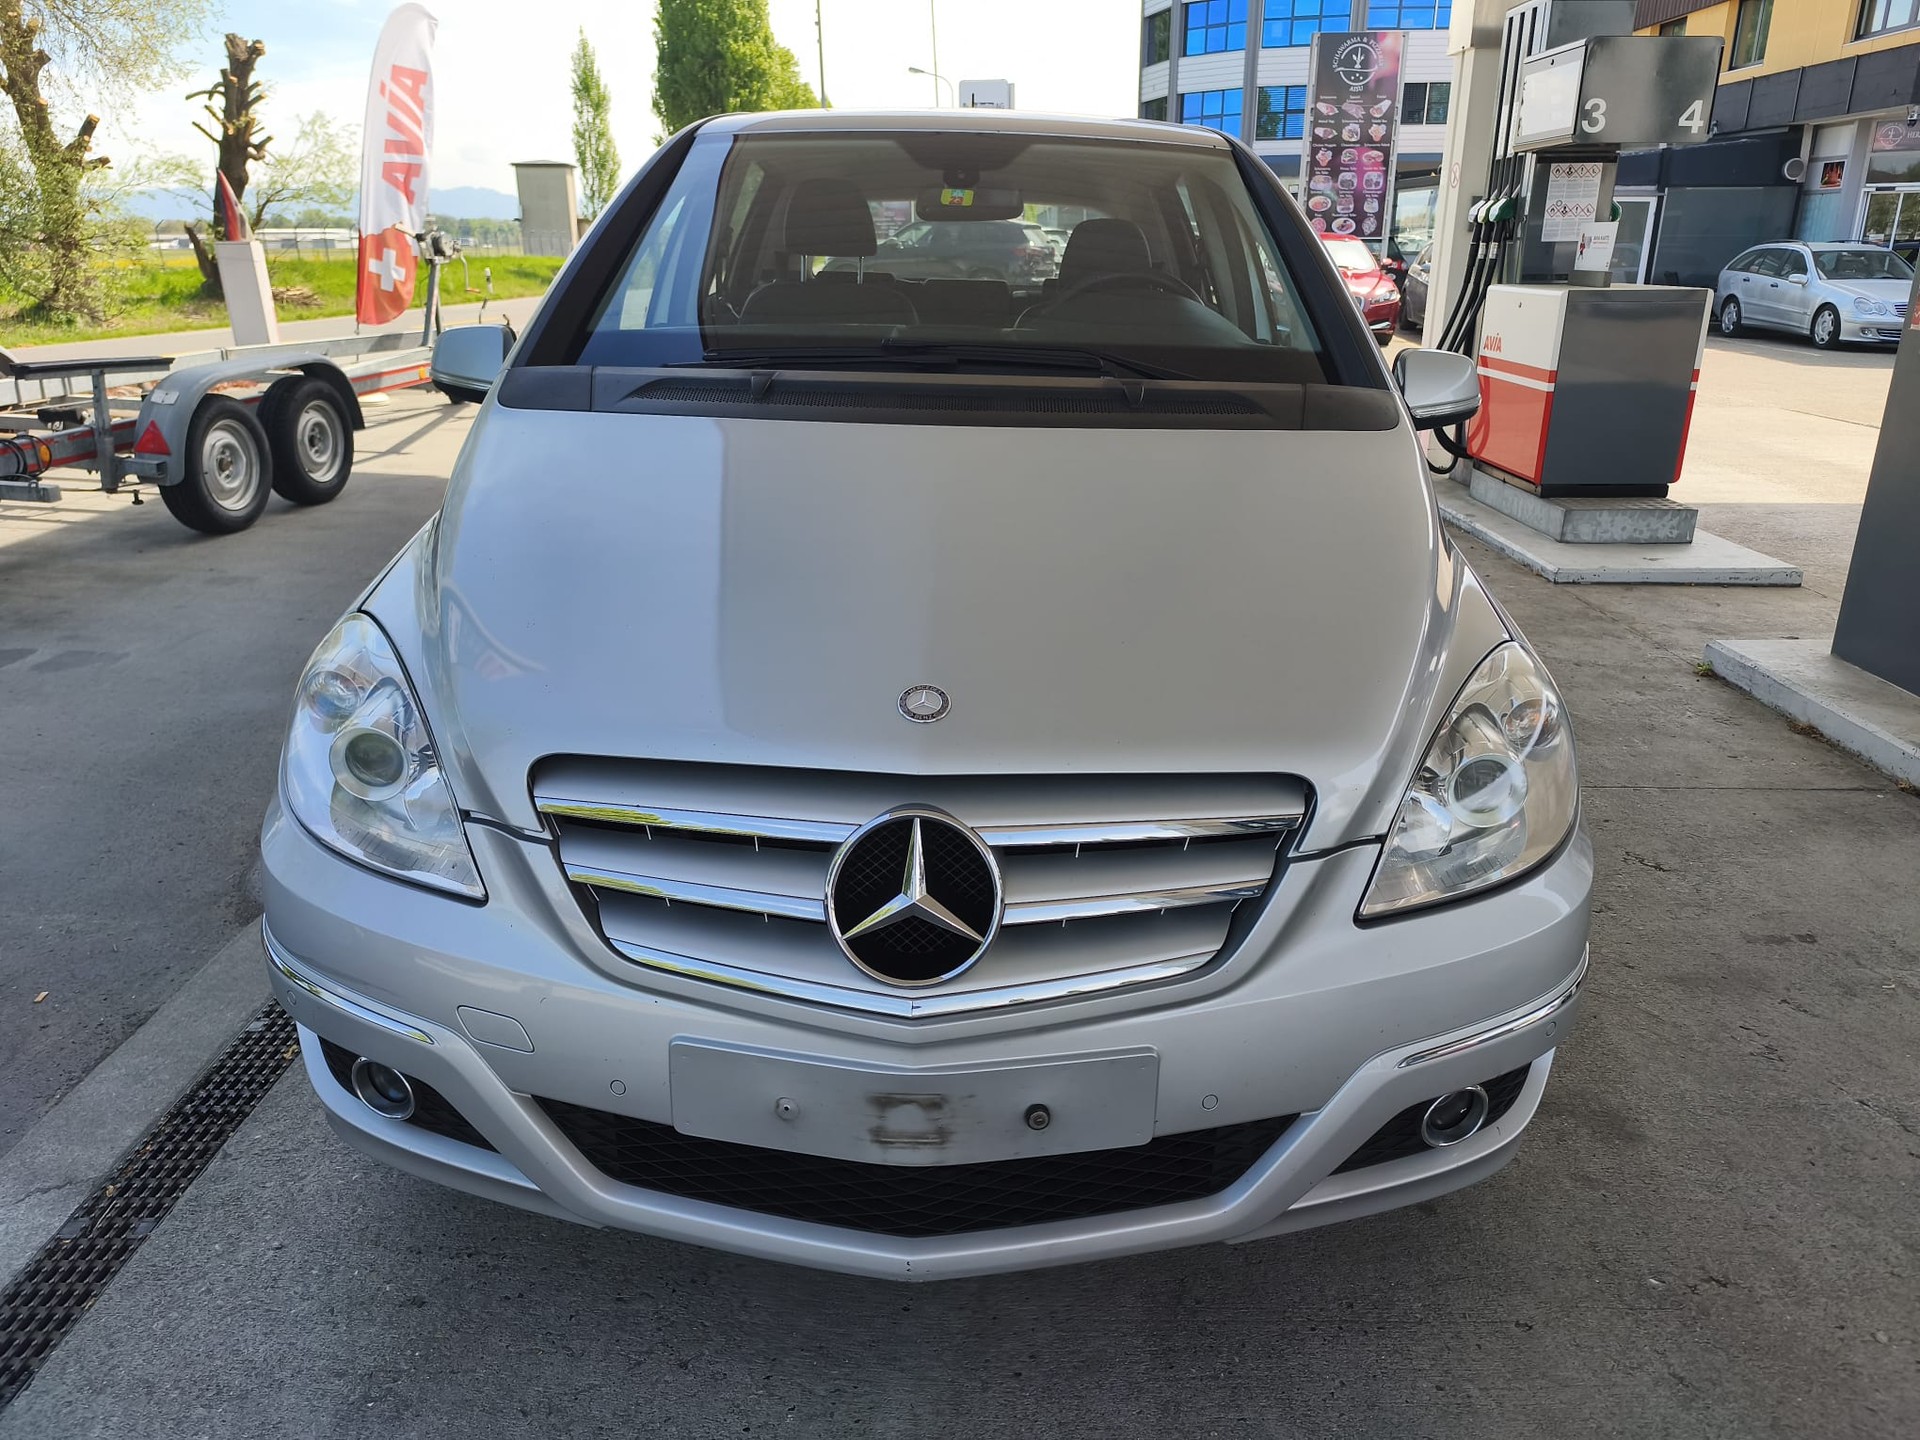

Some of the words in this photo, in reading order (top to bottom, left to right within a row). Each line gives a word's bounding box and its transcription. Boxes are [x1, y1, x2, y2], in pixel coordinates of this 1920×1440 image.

[1332, 36, 1361, 68] SCHAWARMA
[1581, 98, 1607, 133] 3
[1678, 99, 1704, 134] 4
[379, 64, 428, 205] AVIA
[1483, 333, 1502, 353] AVIA
